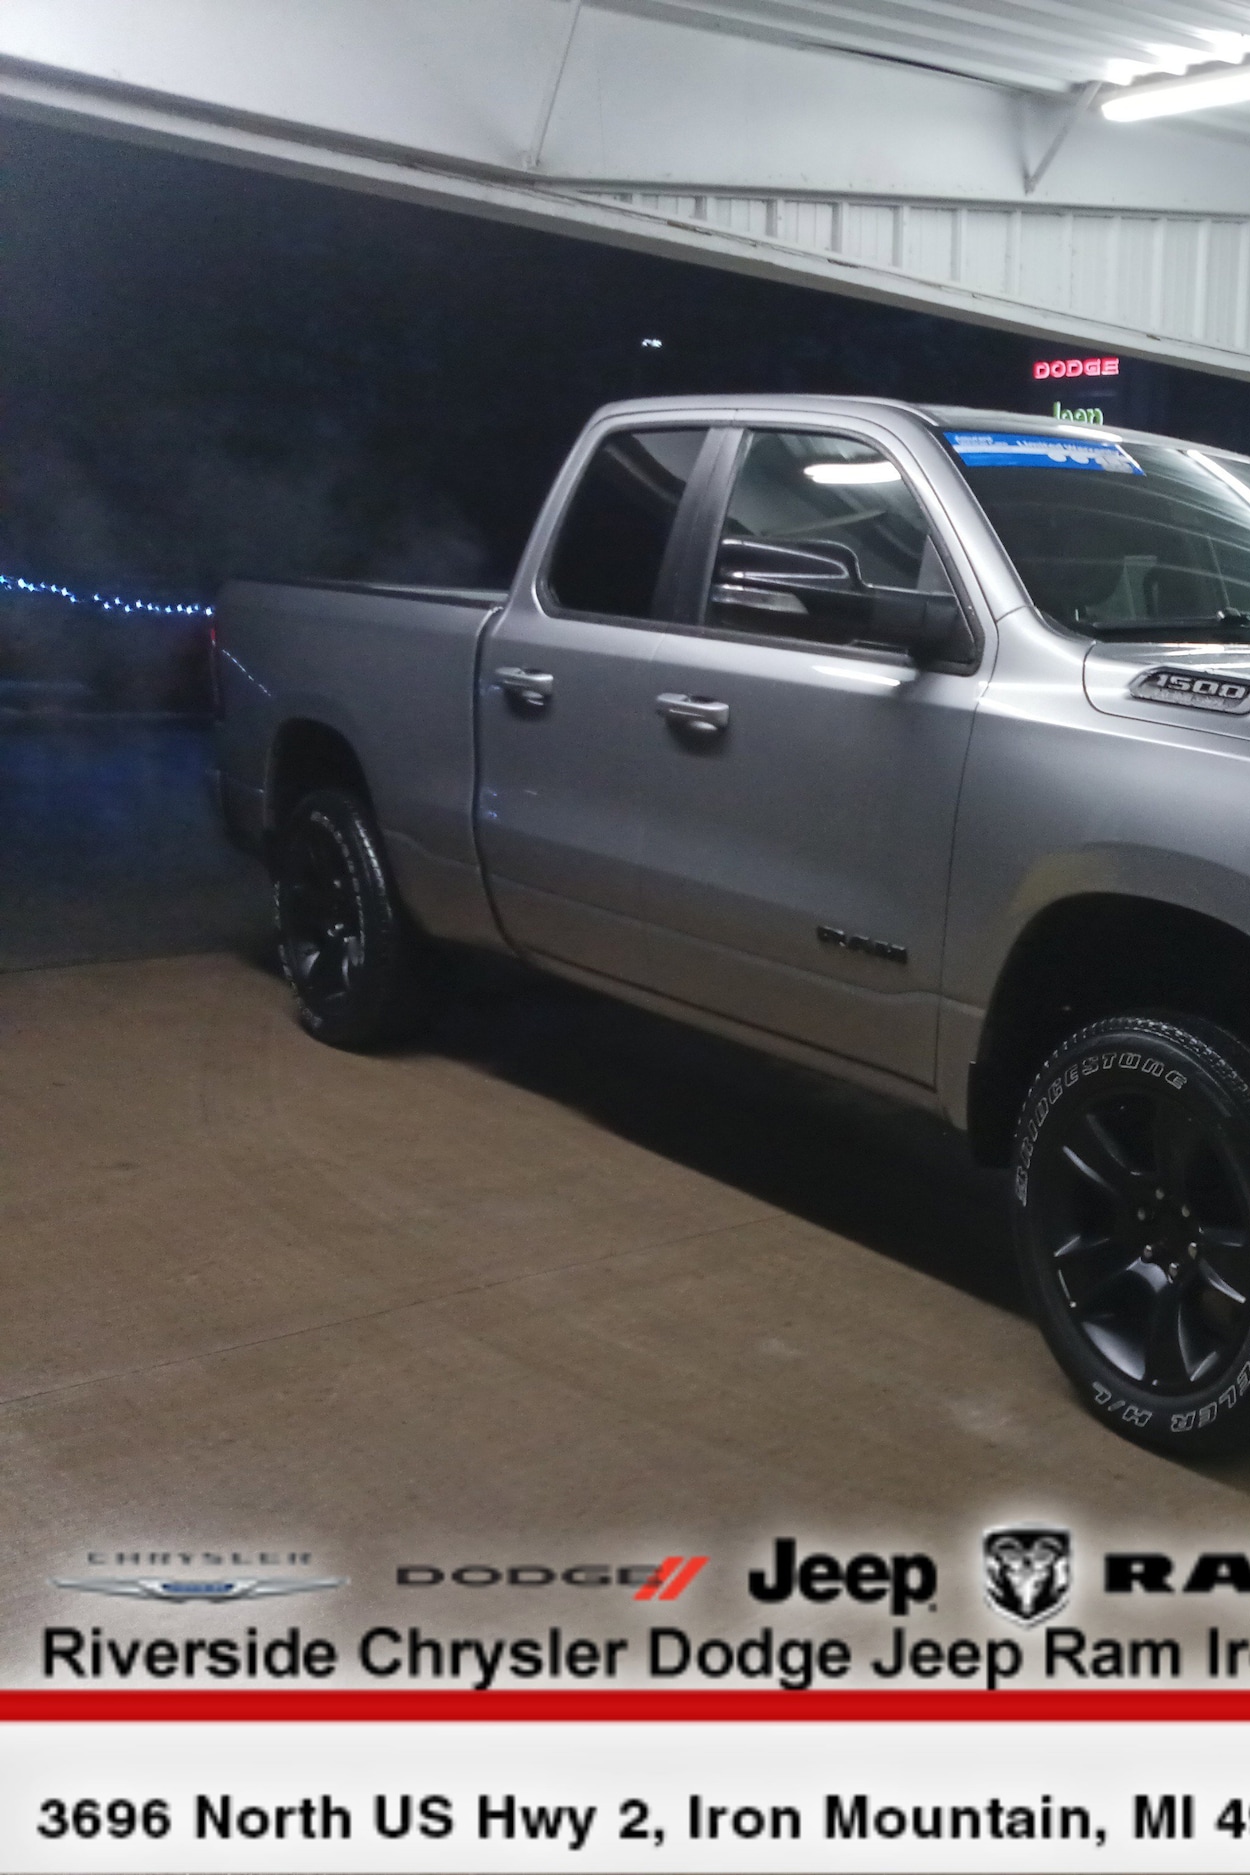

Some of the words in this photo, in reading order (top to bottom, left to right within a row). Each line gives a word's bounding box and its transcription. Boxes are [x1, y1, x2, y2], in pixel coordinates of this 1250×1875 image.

[1033, 357, 1120, 380] DODGE
[1156, 673, 1247, 699] 1500
[1016, 1052, 1188, 1206] BRIDGESTONE
